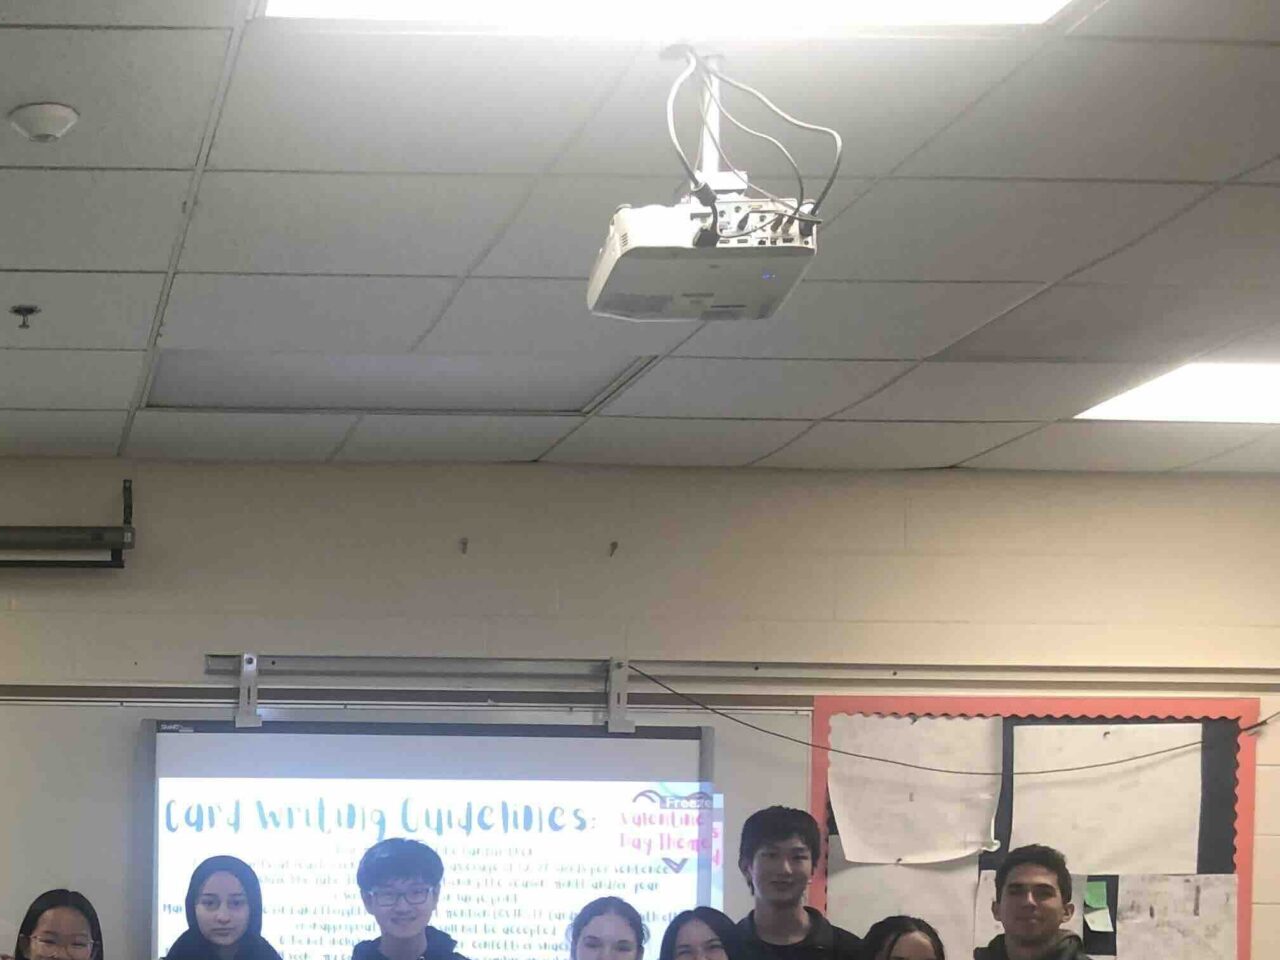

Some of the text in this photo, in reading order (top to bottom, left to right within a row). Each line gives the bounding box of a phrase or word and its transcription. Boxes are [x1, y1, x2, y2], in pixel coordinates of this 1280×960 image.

[165, 797, 597, 842] Card Writing Guidelines:
